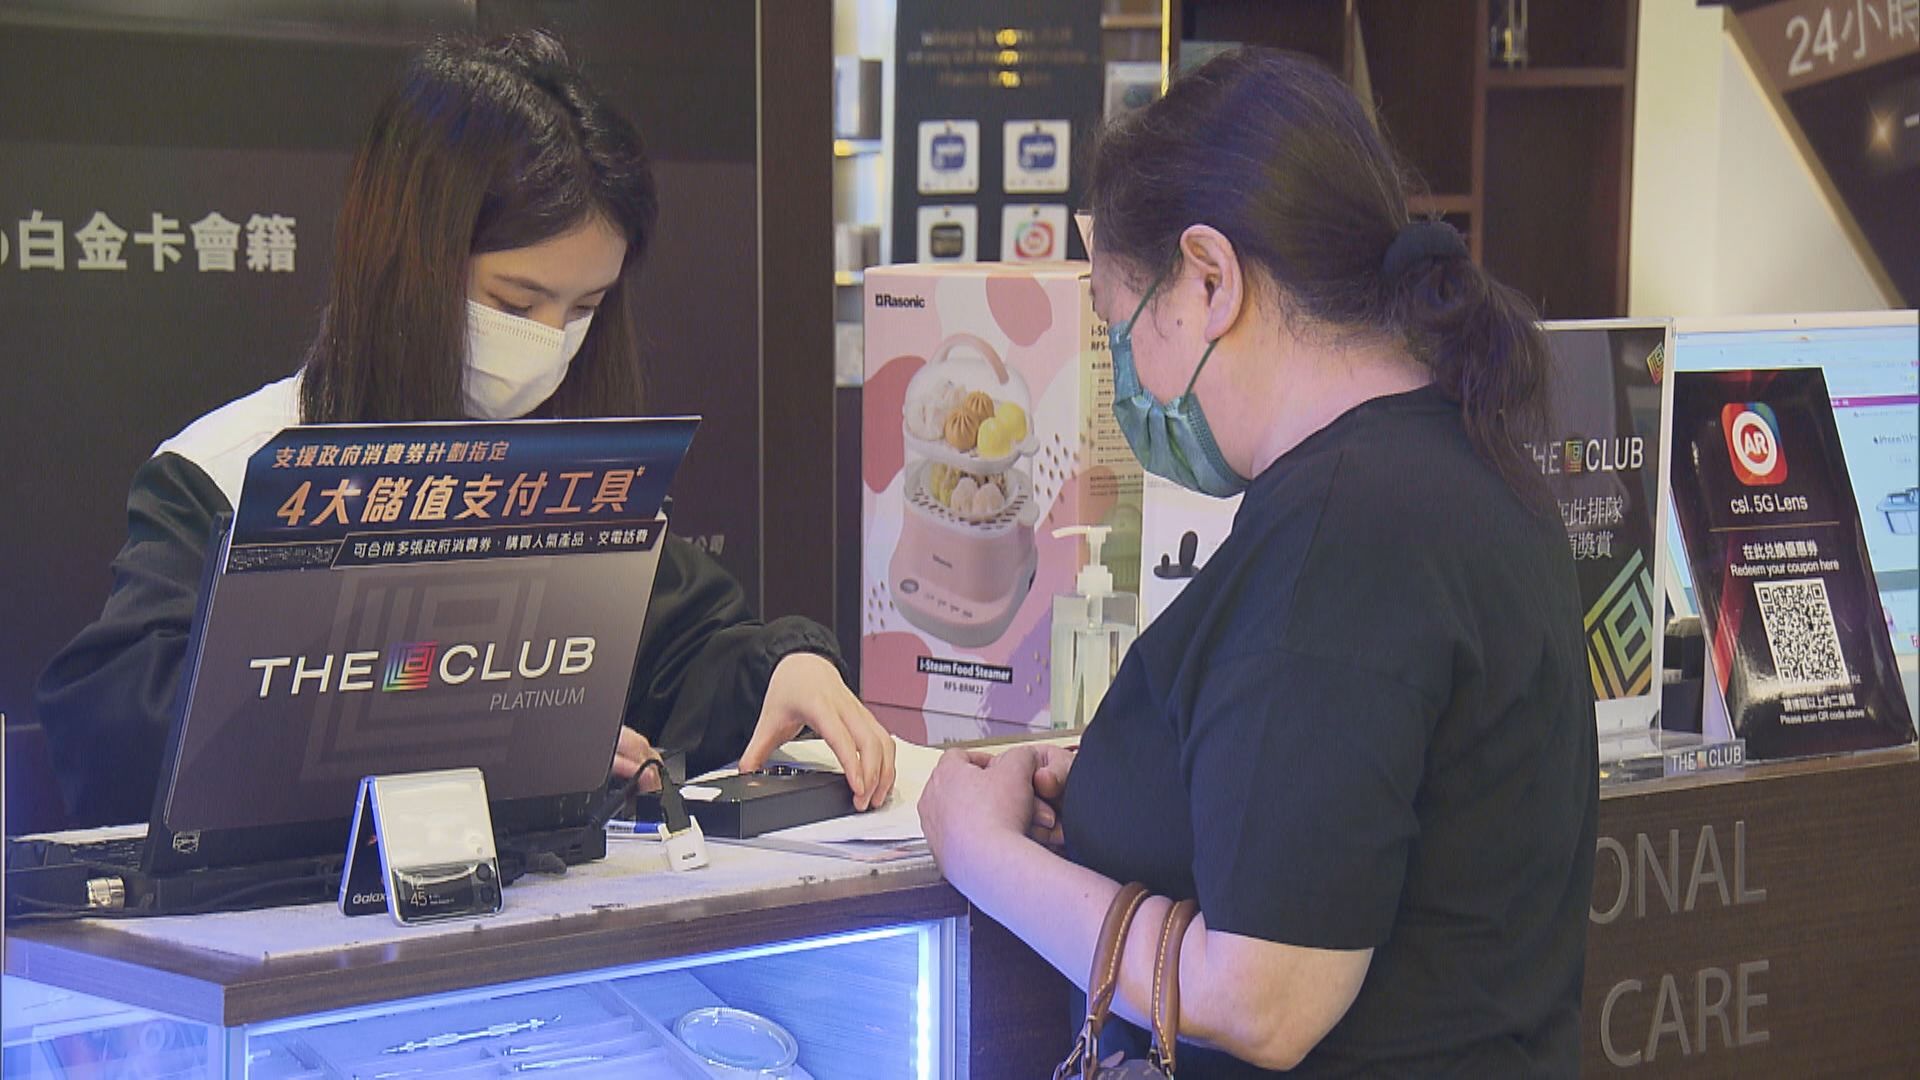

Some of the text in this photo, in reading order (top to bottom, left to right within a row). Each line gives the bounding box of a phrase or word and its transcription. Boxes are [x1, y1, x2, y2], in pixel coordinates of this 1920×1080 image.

[18, 208, 297, 273] 白金卡會籍
[884, 293, 926, 309] Rasonic
[1523, 436, 1644, 475] HE CLUB
[1743, 430, 1769, 456] AR
[1730, 492, 1809, 515] csl. 5G Lens
[1730, 558, 1840, 578] Redeem your coupon here
[249, 636, 597, 699] THE CLUB
[952, 662, 974, 677] Food
[974, 664, 1011, 681] Steamer
[488, 685, 586, 712] PLATINUM
[1779, 713, 1802, 726] Please
[1817, 710, 1829, 722] QR
[1845, 708, 1865, 720] above
[1671, 745, 1742, 773] THE CLUB
[409, 890, 429, 907] 45
[1600, 959, 1770, 1069] CARE
